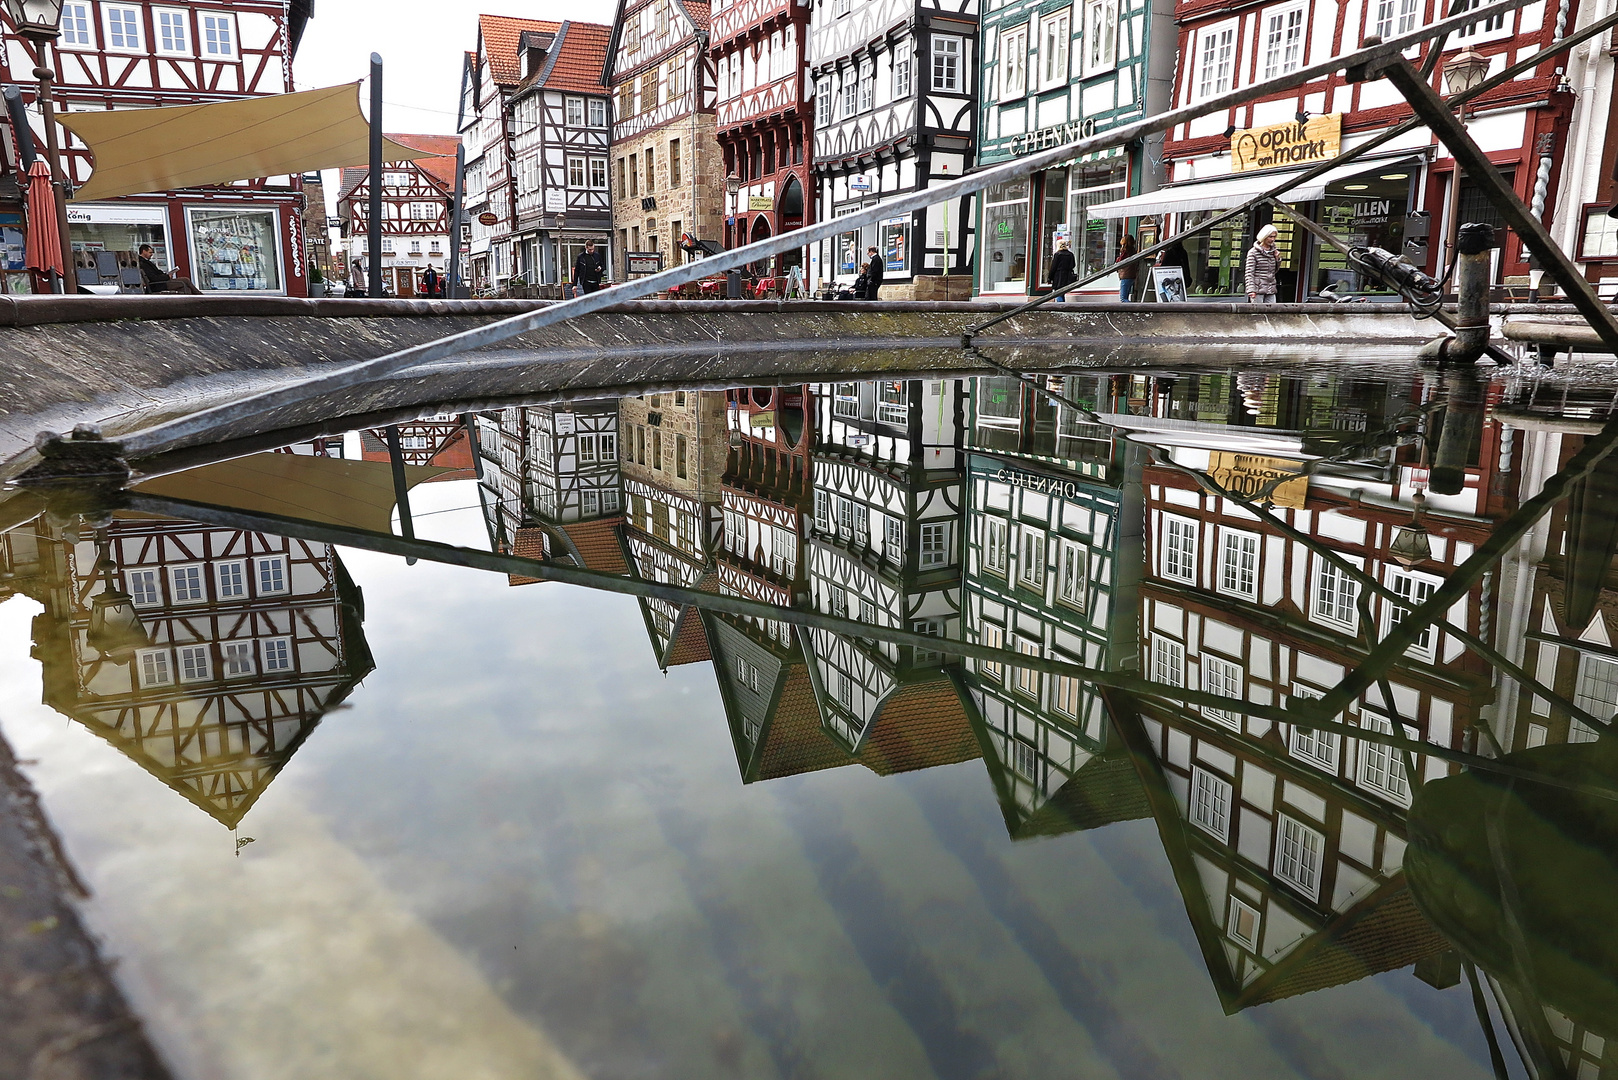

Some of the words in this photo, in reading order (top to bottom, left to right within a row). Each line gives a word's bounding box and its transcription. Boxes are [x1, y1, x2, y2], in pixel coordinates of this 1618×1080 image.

[1260, 123, 1307, 150] optik
[1257, 155, 1272, 166] am
[1273, 139, 1325, 163] markt
